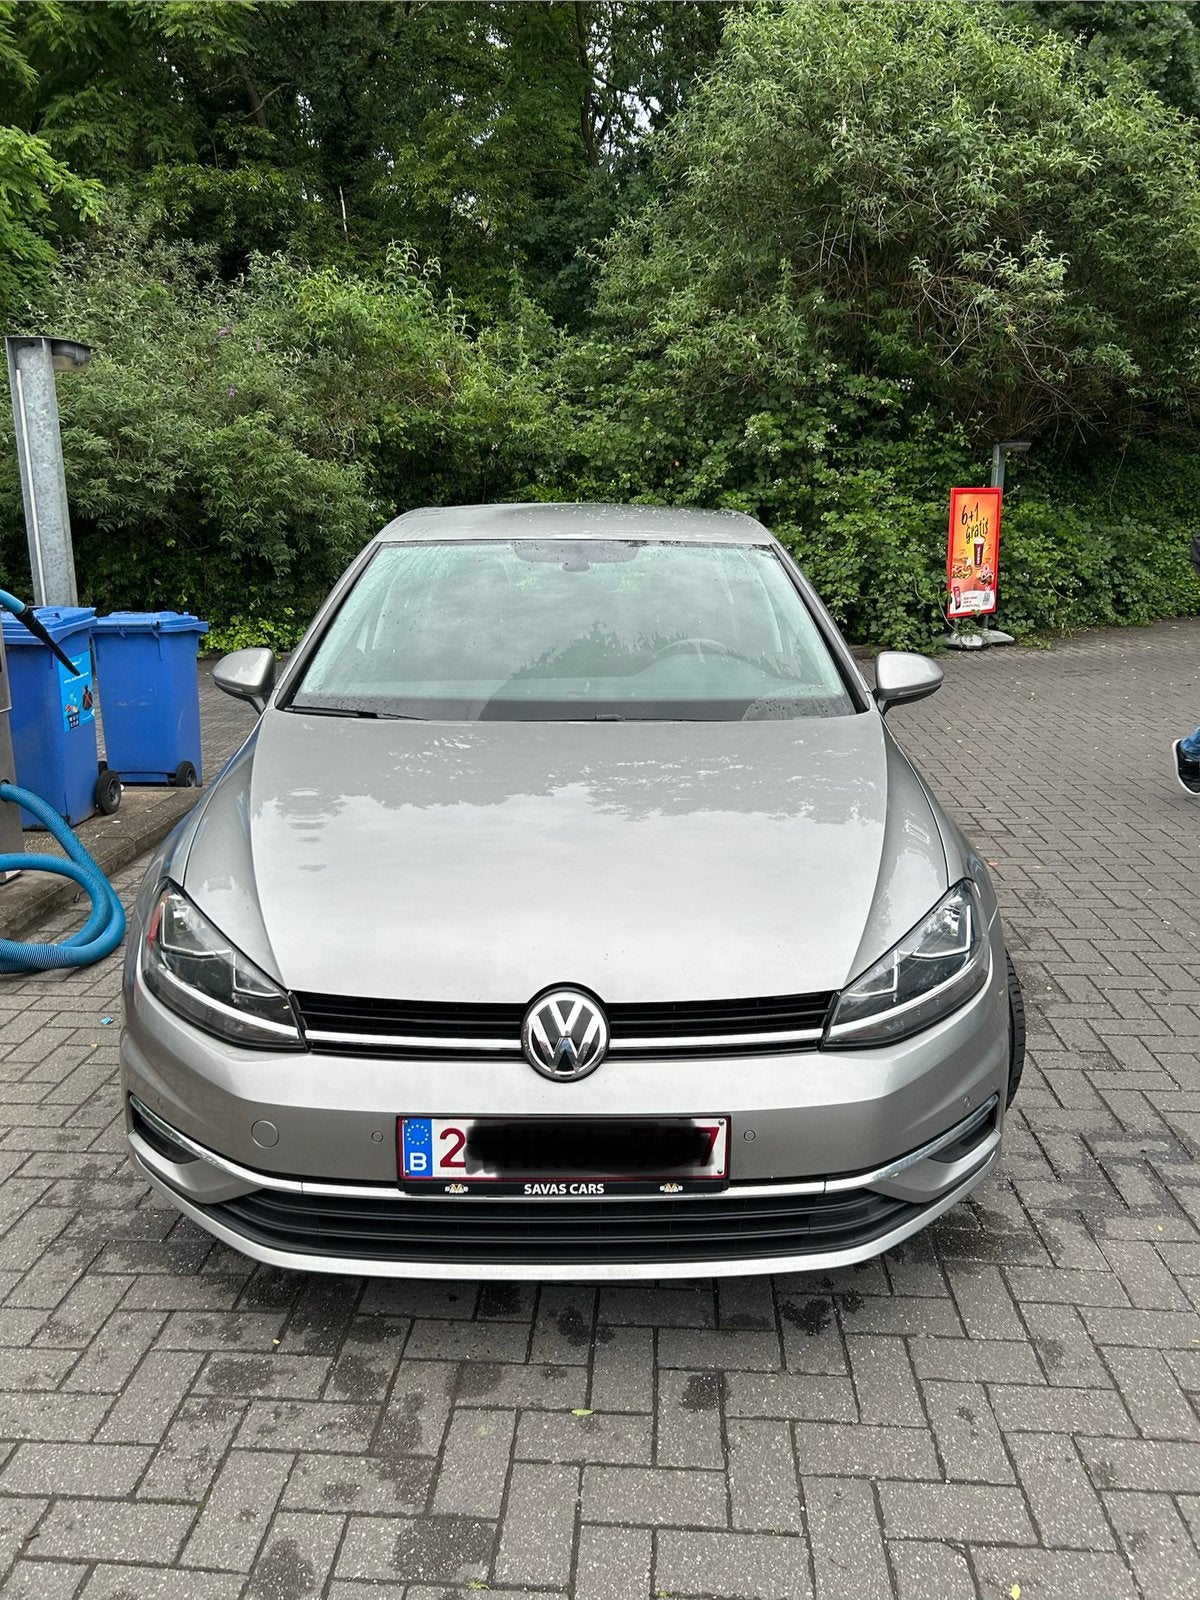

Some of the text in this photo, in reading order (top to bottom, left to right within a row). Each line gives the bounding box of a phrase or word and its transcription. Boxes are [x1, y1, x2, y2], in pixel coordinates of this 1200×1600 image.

[961, 502, 979, 525] 6+1
[965, 518, 988, 544] gratis
[409, 1152, 427, 1171] B
[523, 1183, 605, 1195] SAVAS CARS
